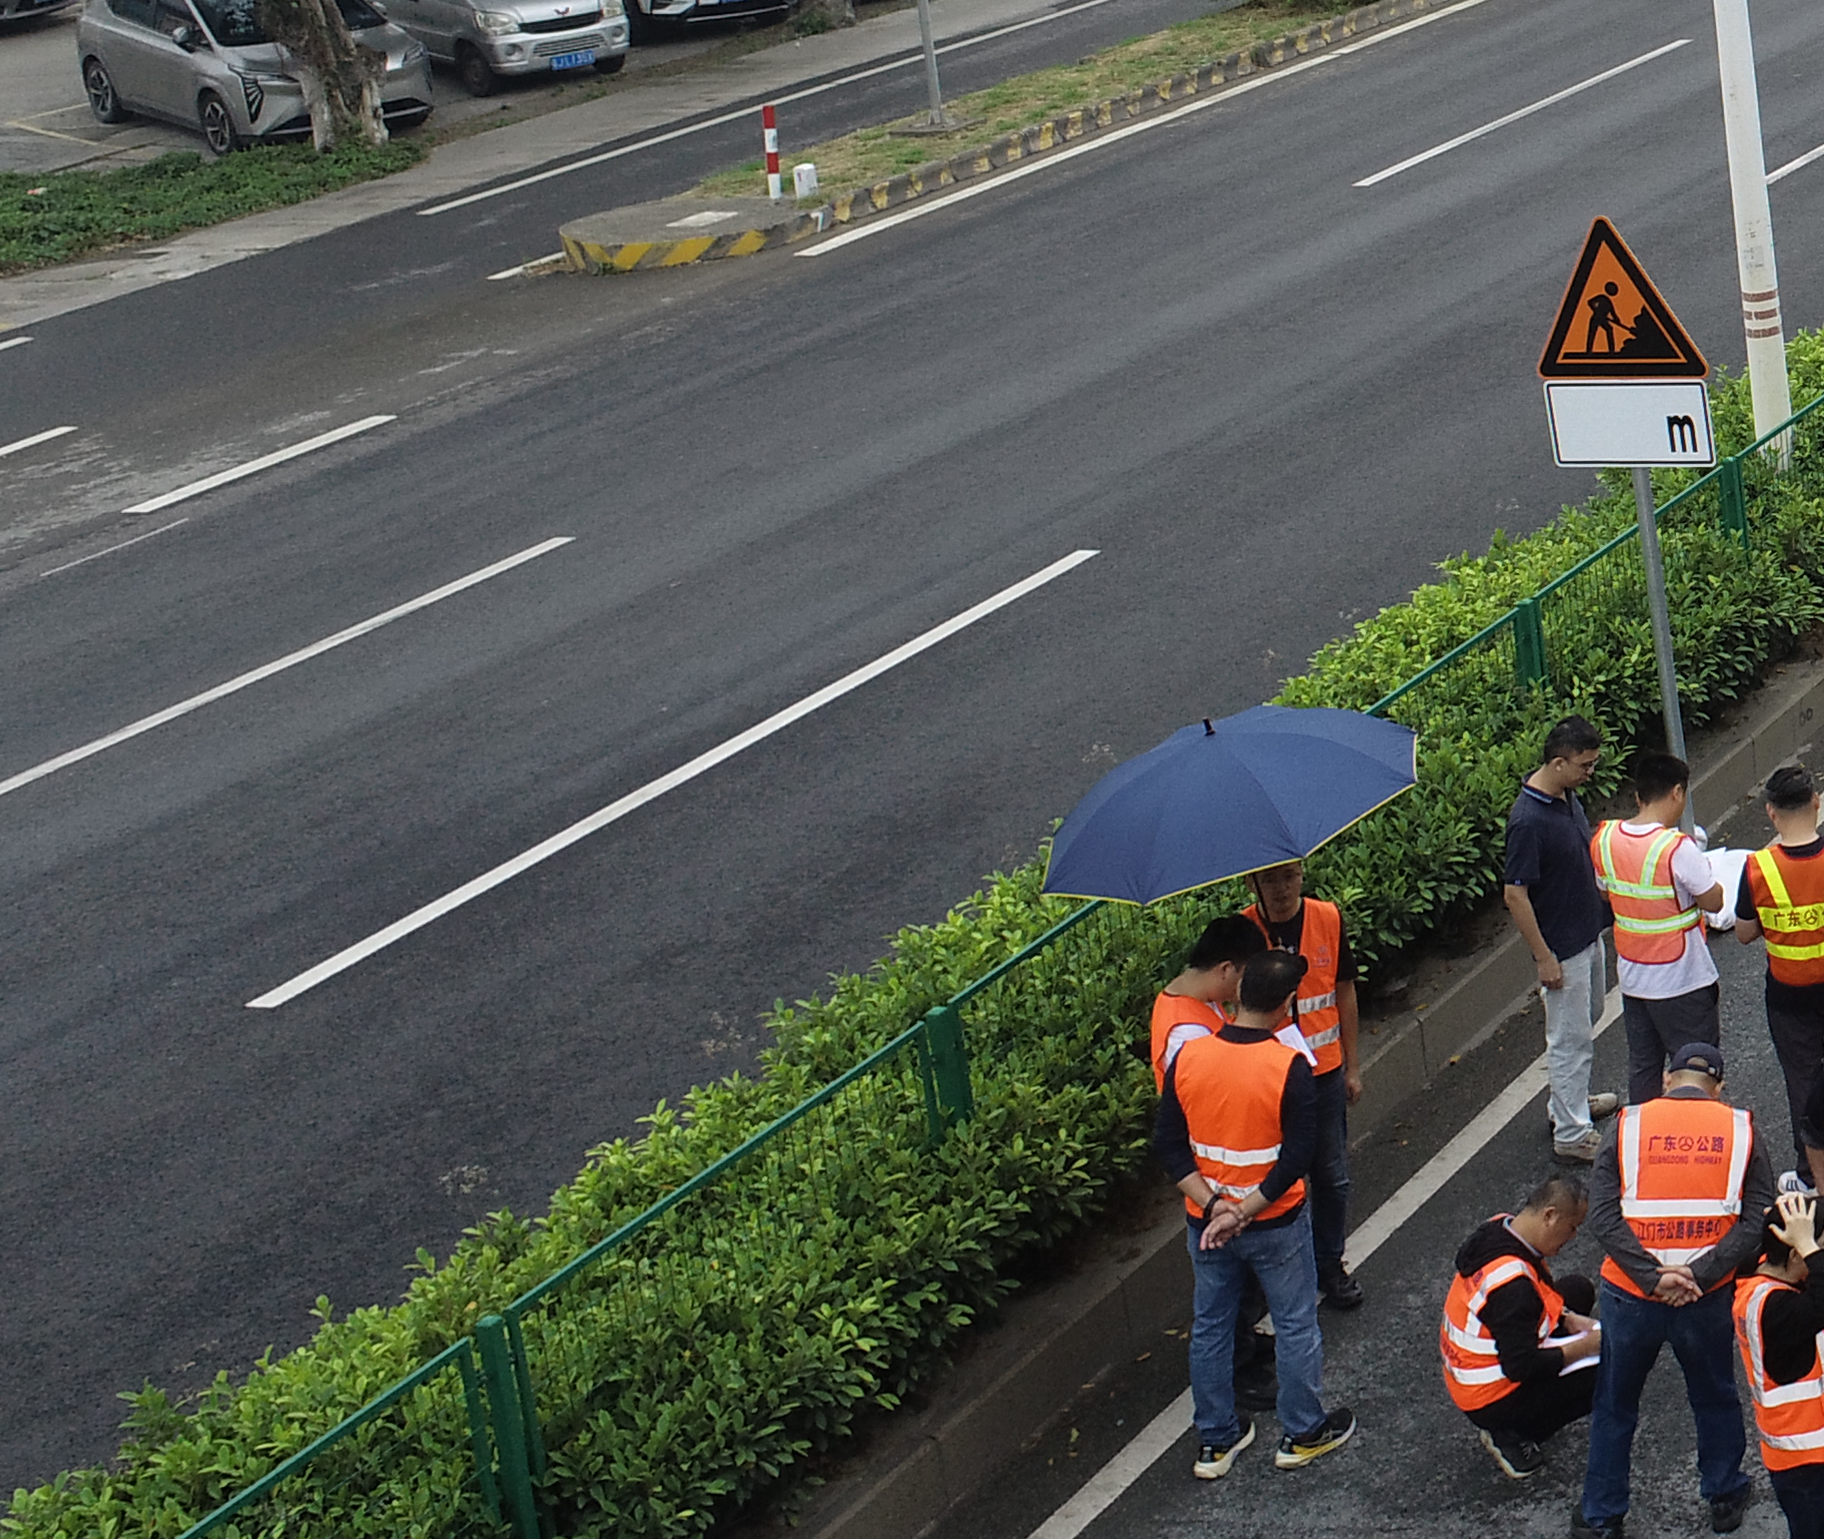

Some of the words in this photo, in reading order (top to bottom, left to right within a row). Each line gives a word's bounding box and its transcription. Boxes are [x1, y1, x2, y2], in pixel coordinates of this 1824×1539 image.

[1667, 415, 1698, 453] m
[1648, 1135, 1725, 1154] 广东公路
[1638, 1218, 1722, 1242] 江门市公路事务中心
